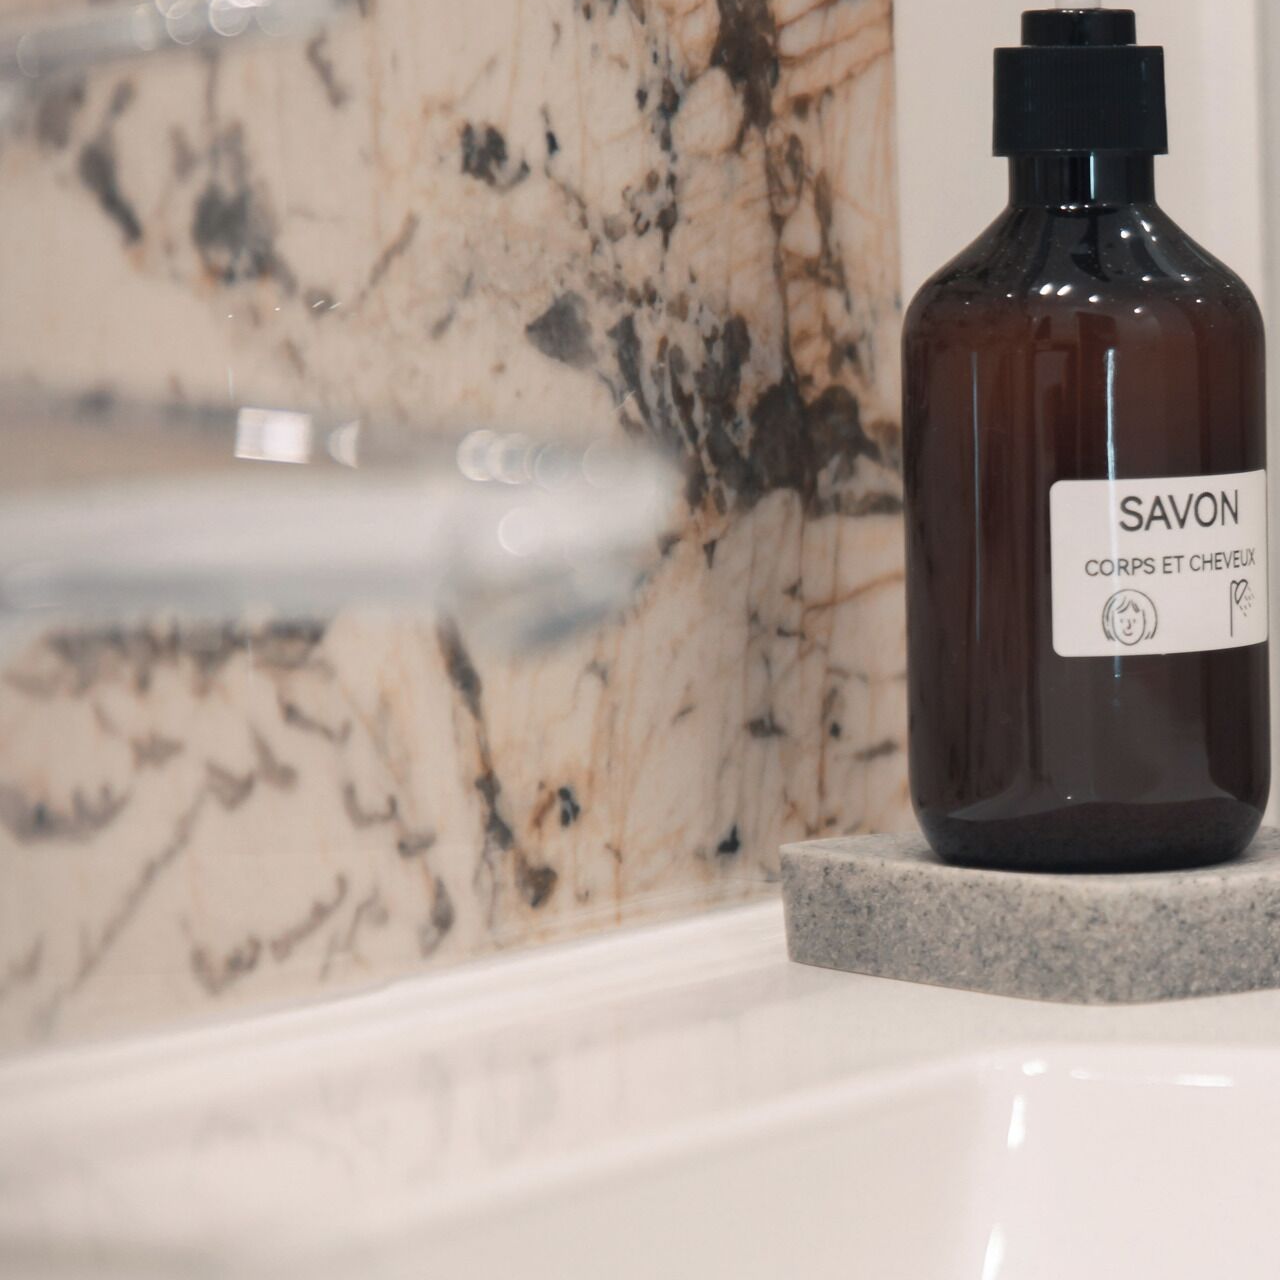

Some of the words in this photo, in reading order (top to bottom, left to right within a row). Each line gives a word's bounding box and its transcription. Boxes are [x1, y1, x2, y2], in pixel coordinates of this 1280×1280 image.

[1119, 489, 1239, 532] SAVON
[1084, 558, 1156, 577] CORPS
[1162, 555, 1185, 574] ET
[1189, 548, 1256, 572] CHEVEUX
